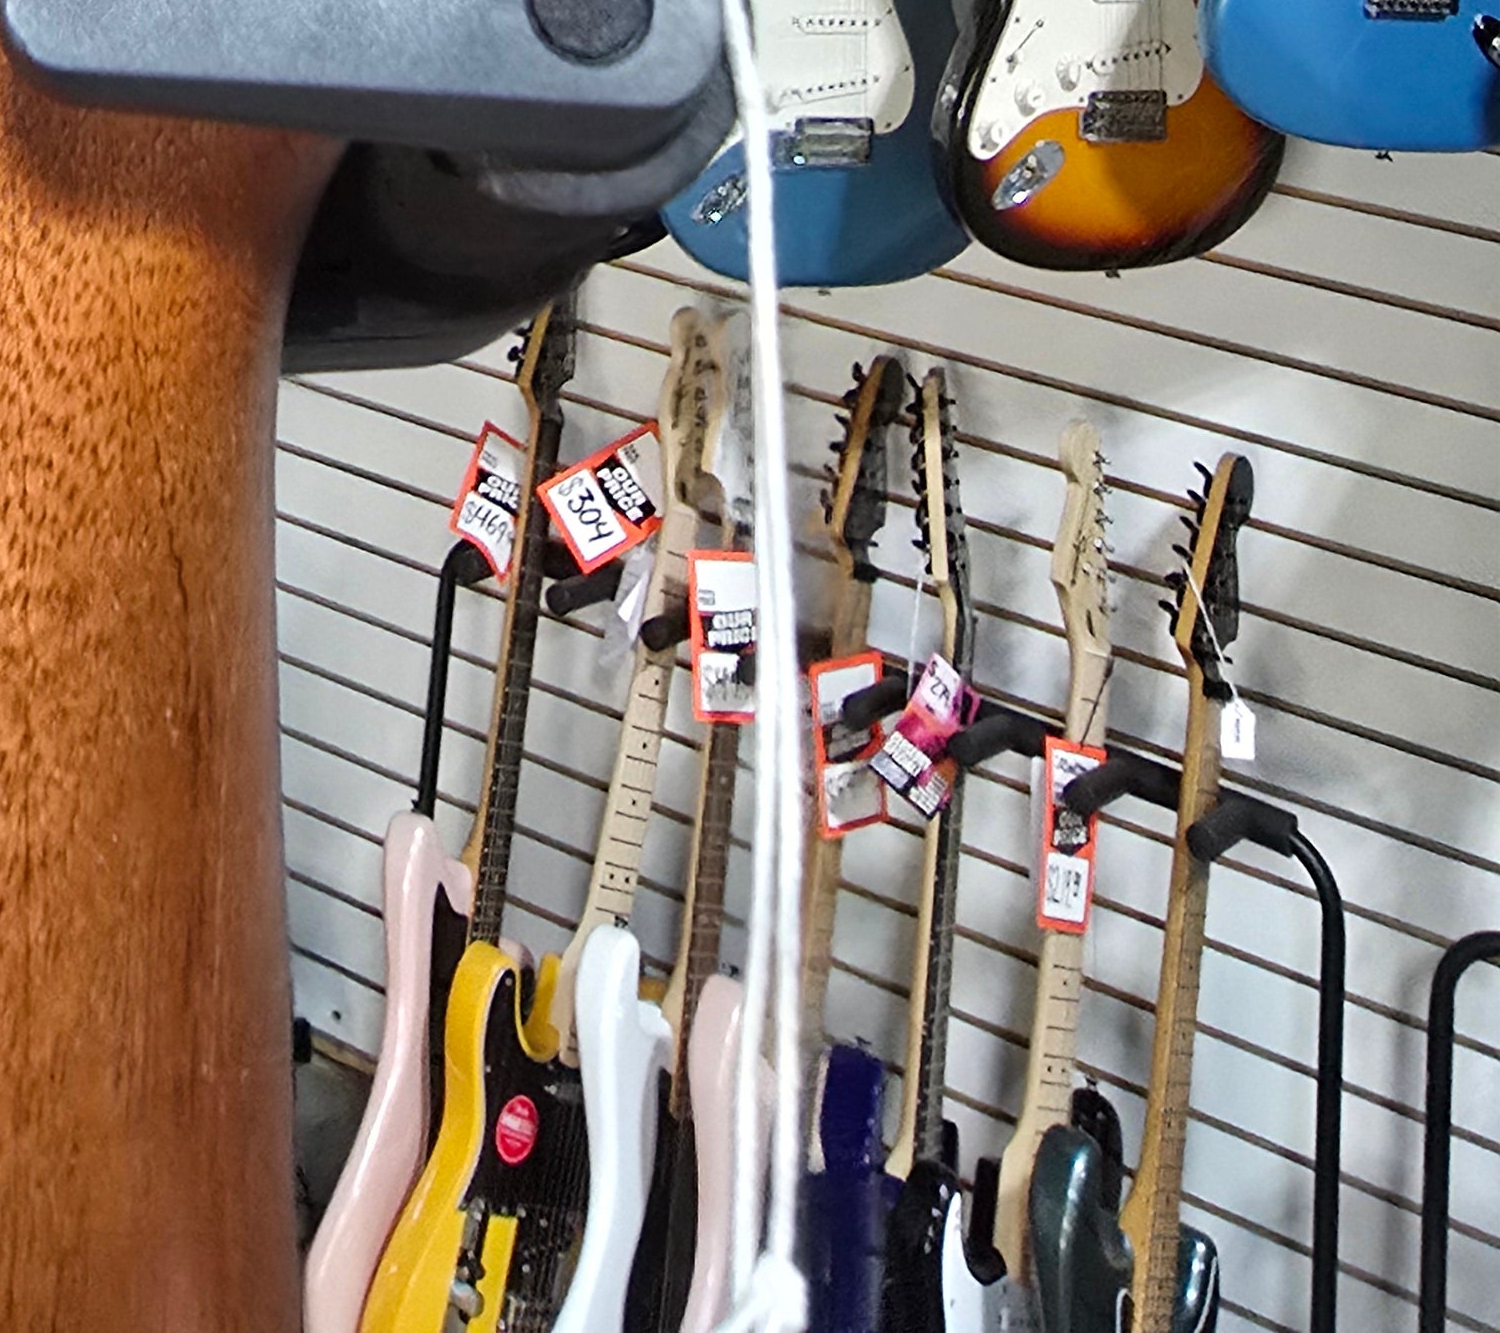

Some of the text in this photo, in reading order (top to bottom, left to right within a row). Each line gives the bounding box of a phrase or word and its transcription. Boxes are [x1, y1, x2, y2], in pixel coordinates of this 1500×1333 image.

[477, 481, 519, 509] PRIC
[486, 474, 520, 497] OU
[596, 466, 644, 523] PRICE
[611, 466, 648, 506] OUR
[558, 475, 615, 543] $304
